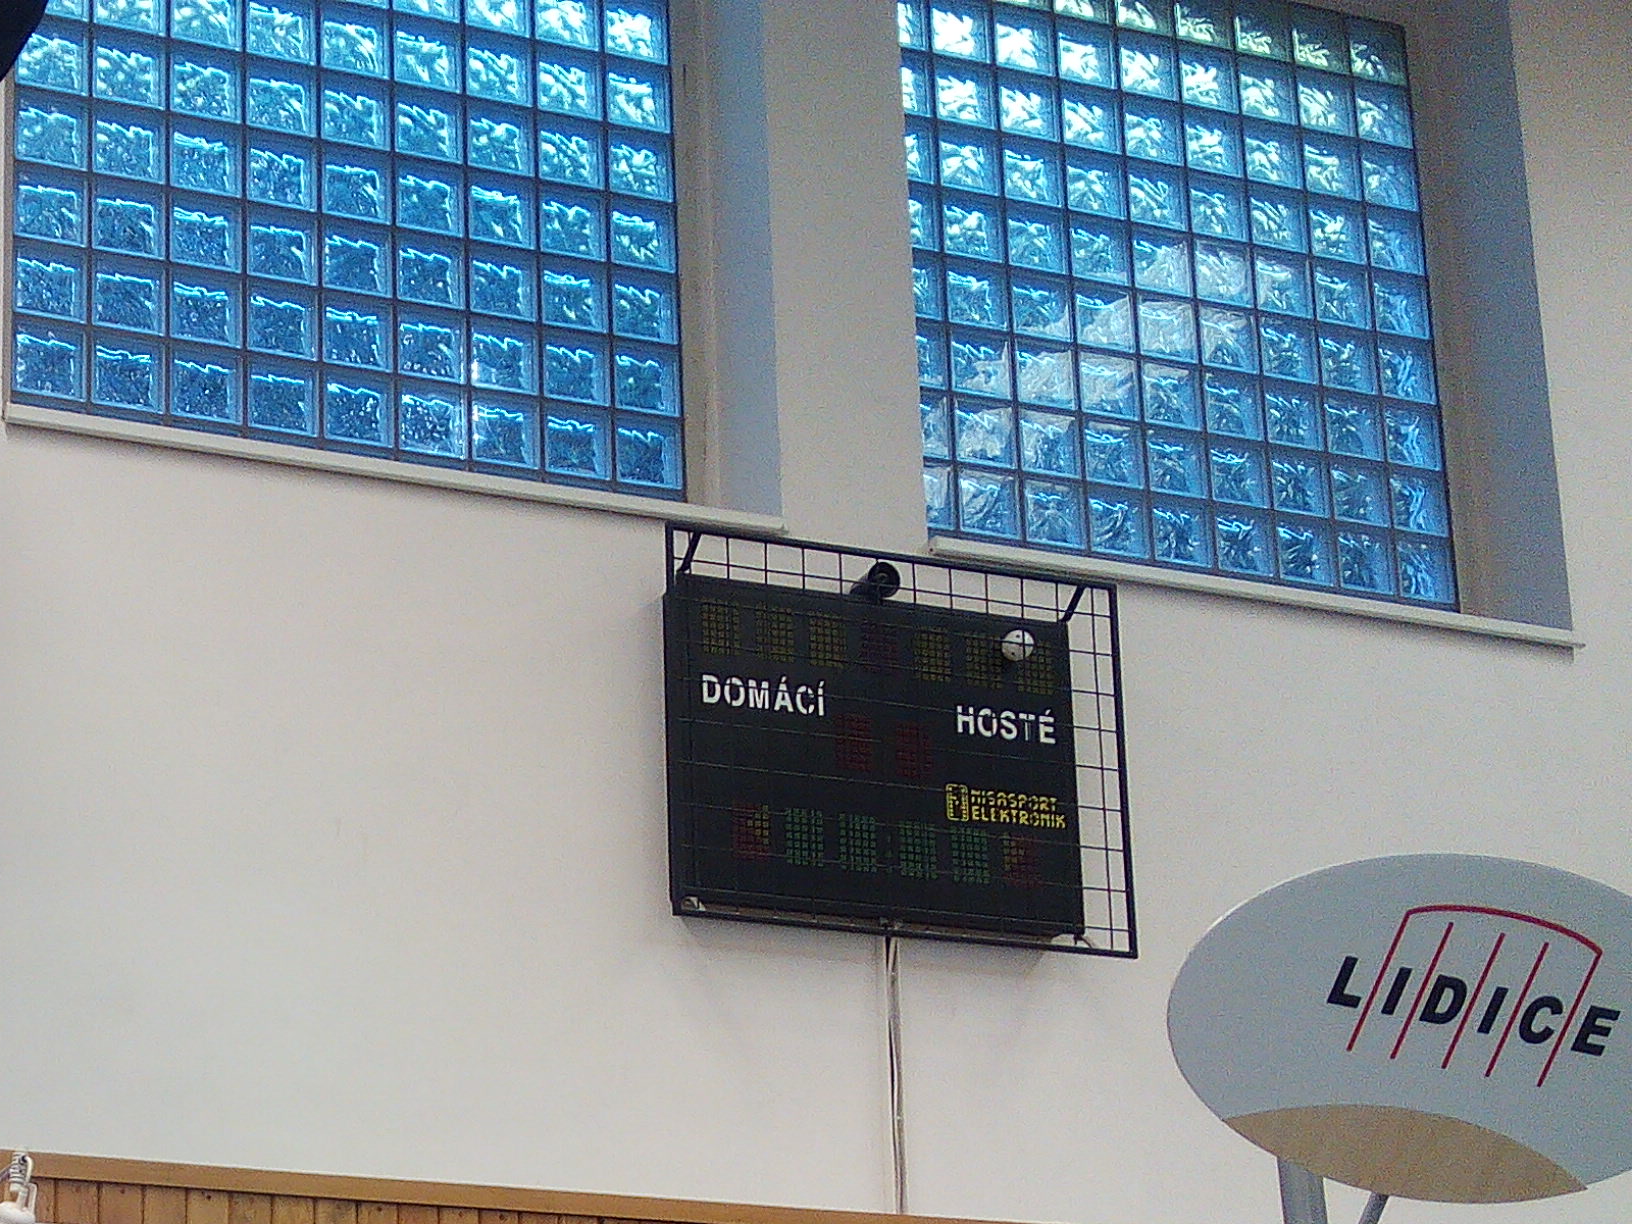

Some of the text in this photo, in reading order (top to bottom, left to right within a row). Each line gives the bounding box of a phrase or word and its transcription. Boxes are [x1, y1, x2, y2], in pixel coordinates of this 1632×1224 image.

[702, 674, 826, 717] DOMÁCÍ
[956, 705, 1057, 745] HOSTÉ
[971, 805, 1066, 829] ELEKTRONIK
[1326, 955, 1622, 1058] LIDICE
